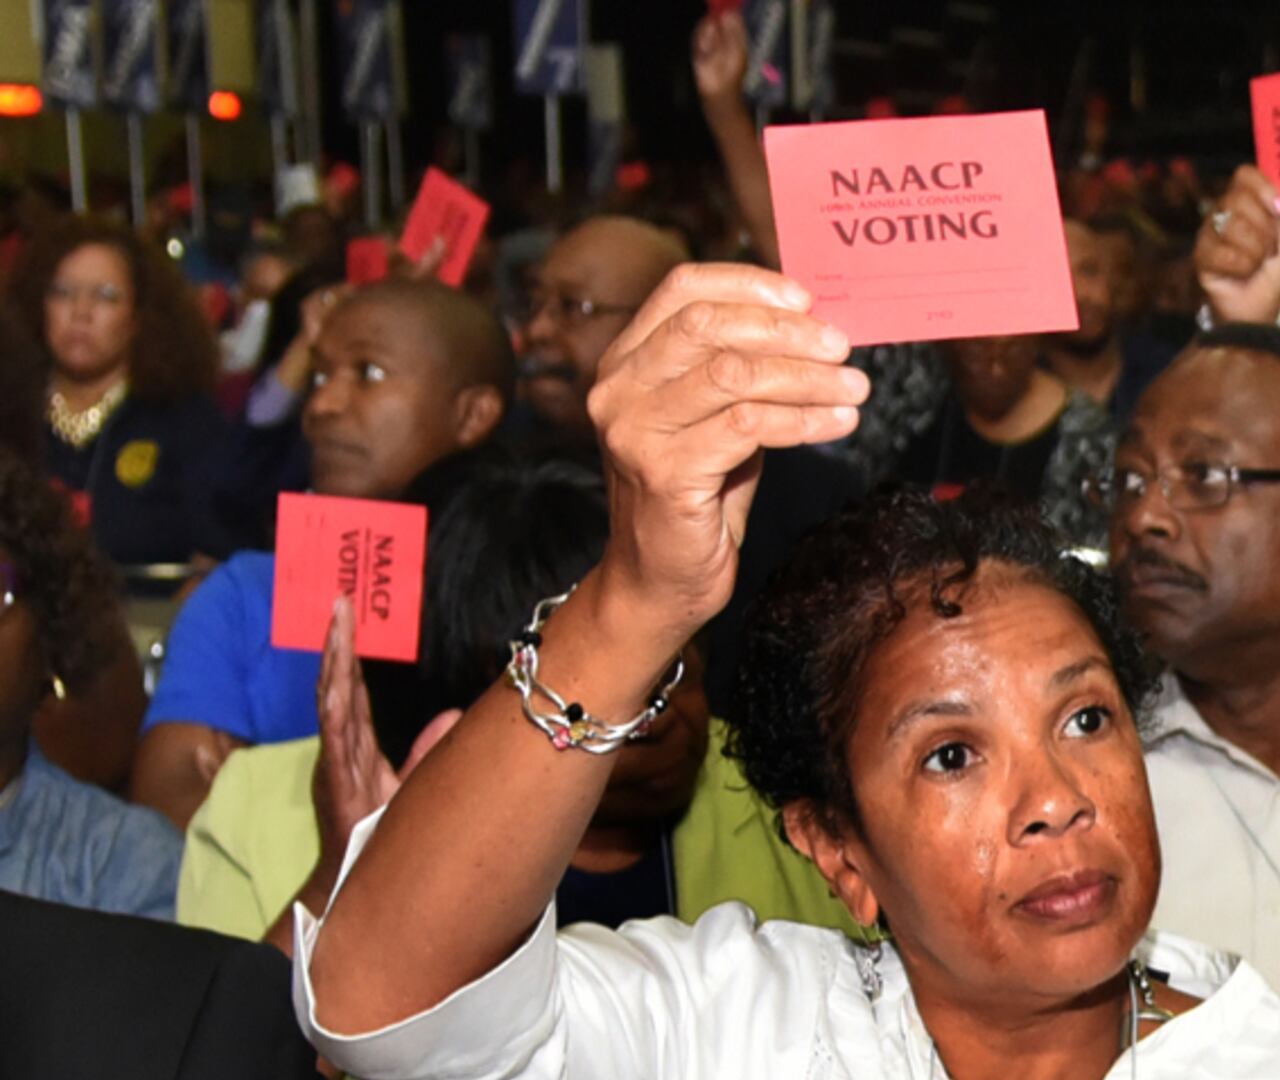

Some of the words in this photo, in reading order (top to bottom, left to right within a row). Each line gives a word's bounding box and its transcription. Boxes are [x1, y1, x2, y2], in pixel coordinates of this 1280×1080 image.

[830, 161, 983, 198] NAACP
[858, 198, 912, 210] ANNUAL
[917, 193, 1003, 207] CONVENTION
[831, 209, 999, 247] VOTING
[371, 535, 393, 620] NAACP
